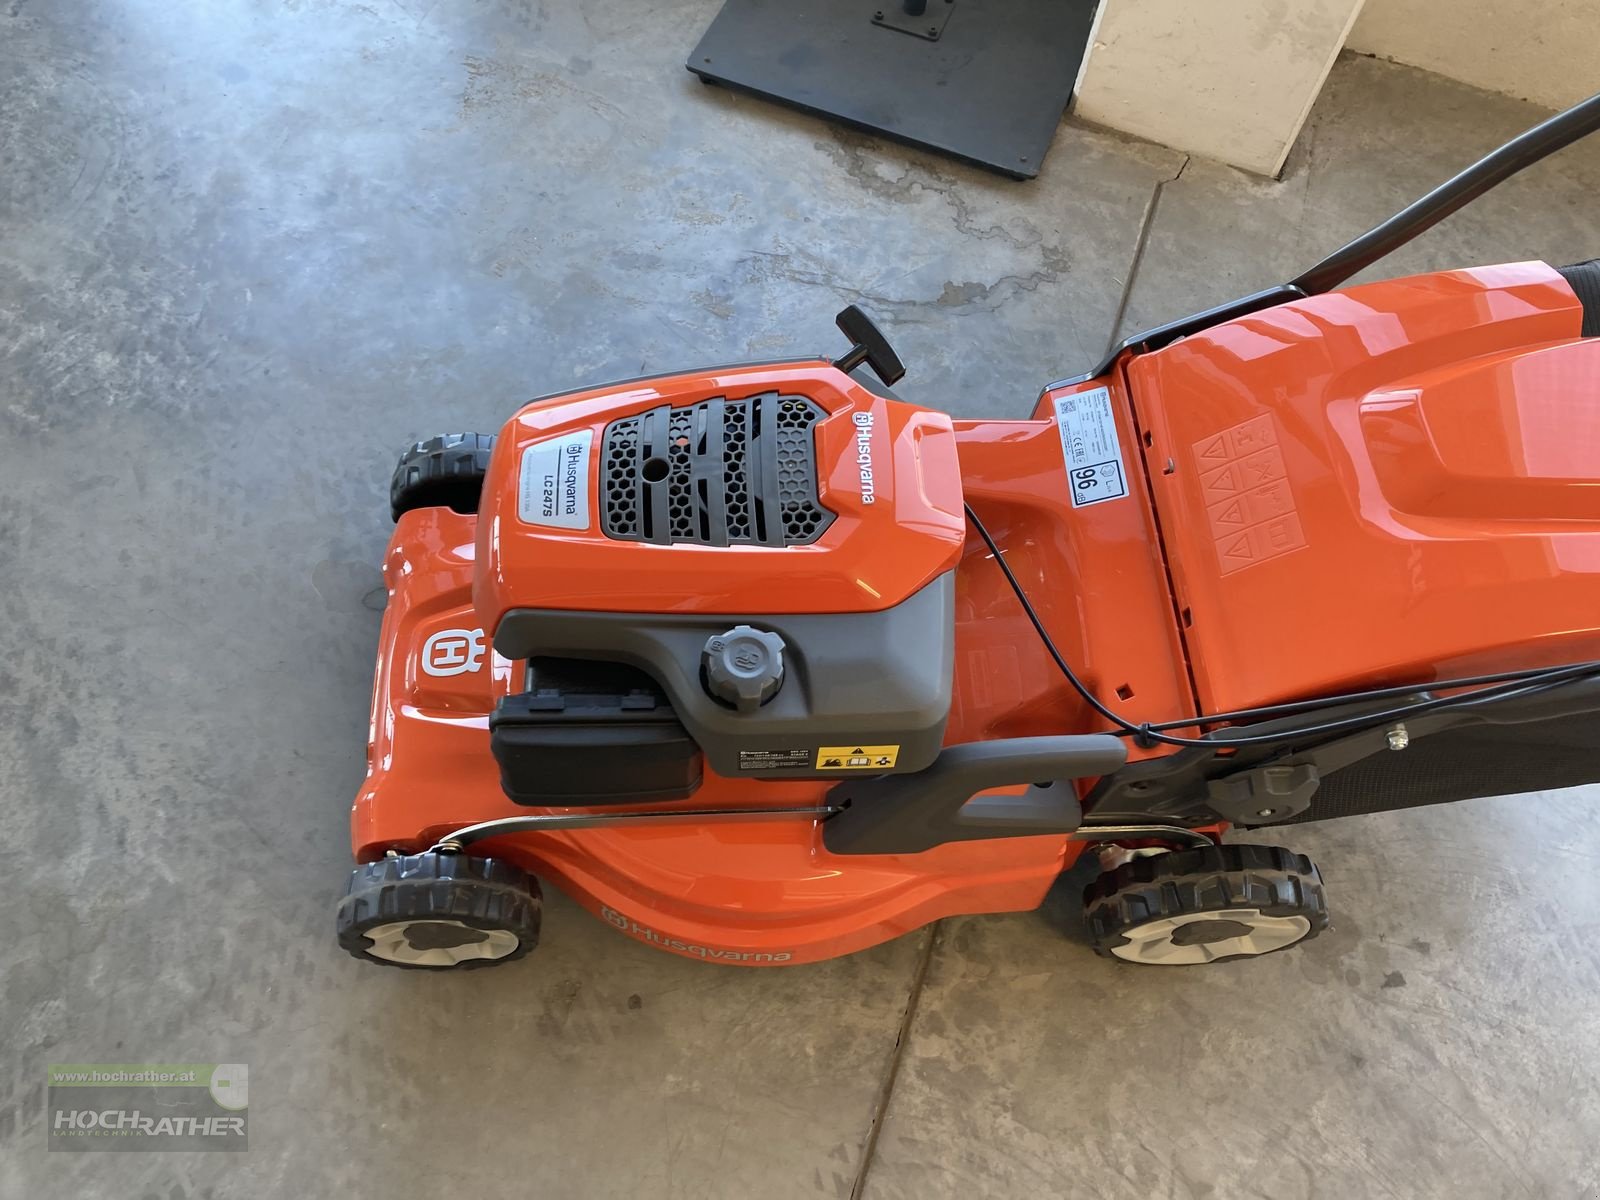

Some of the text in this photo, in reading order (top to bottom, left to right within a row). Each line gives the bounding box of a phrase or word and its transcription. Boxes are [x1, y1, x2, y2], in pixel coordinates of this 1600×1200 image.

[564, 454, 580, 515] Husqvarna
[856, 426, 875, 505] Husqvarna
[1075, 468, 1098, 490] 96
[542, 475, 554, 517] LC 247S
[631, 923, 792, 962] Husqvarna
